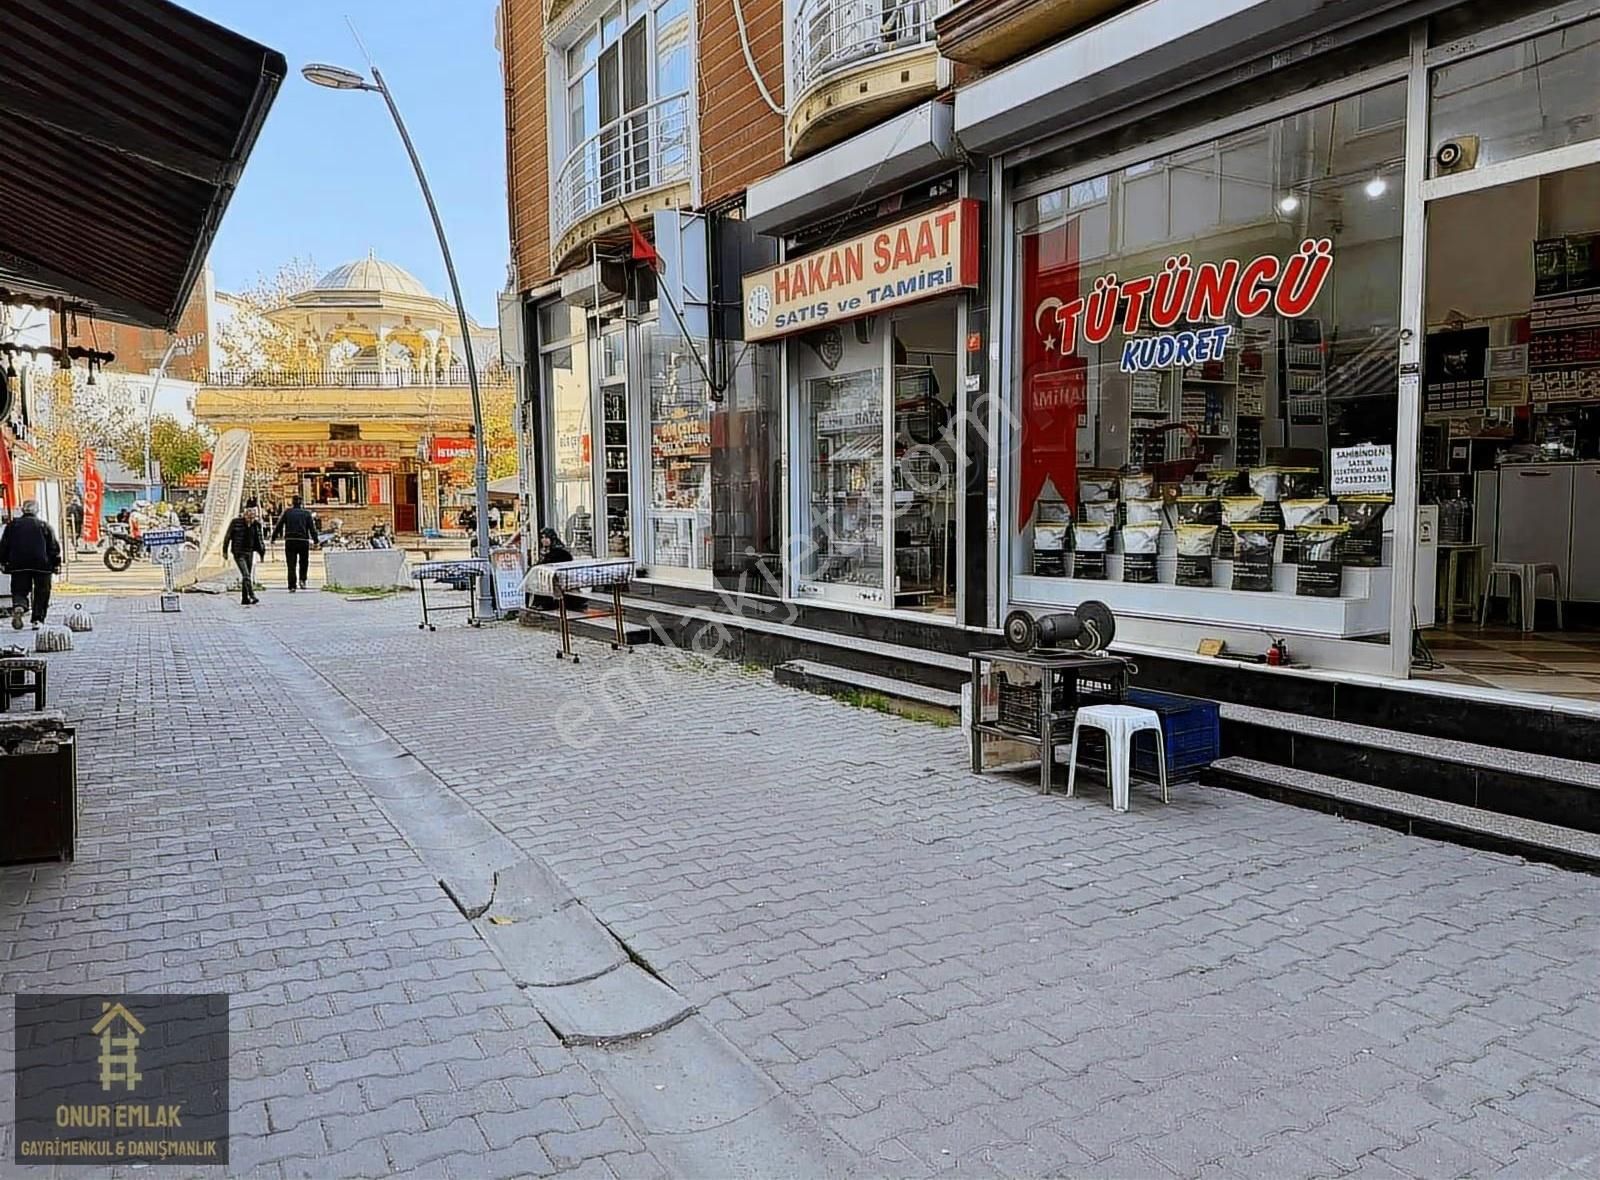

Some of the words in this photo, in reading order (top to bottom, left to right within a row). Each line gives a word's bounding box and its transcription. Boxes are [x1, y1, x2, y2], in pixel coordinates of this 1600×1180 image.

[774, 243, 863, 304] HAKAN
[874, 211, 956, 274] SAAT
[775, 301, 829, 328] SATIŞ
[838, 296, 861, 312] ve
[867, 262, 953, 304] TAMİRİ
[1056, 238, 1333, 354] TÜTÜNCÜ
[174, 332, 205, 348] MHP
[1120, 325, 1232, 373] KUDRET
[1336, 447, 1385, 458] SAHİBİNDEN
